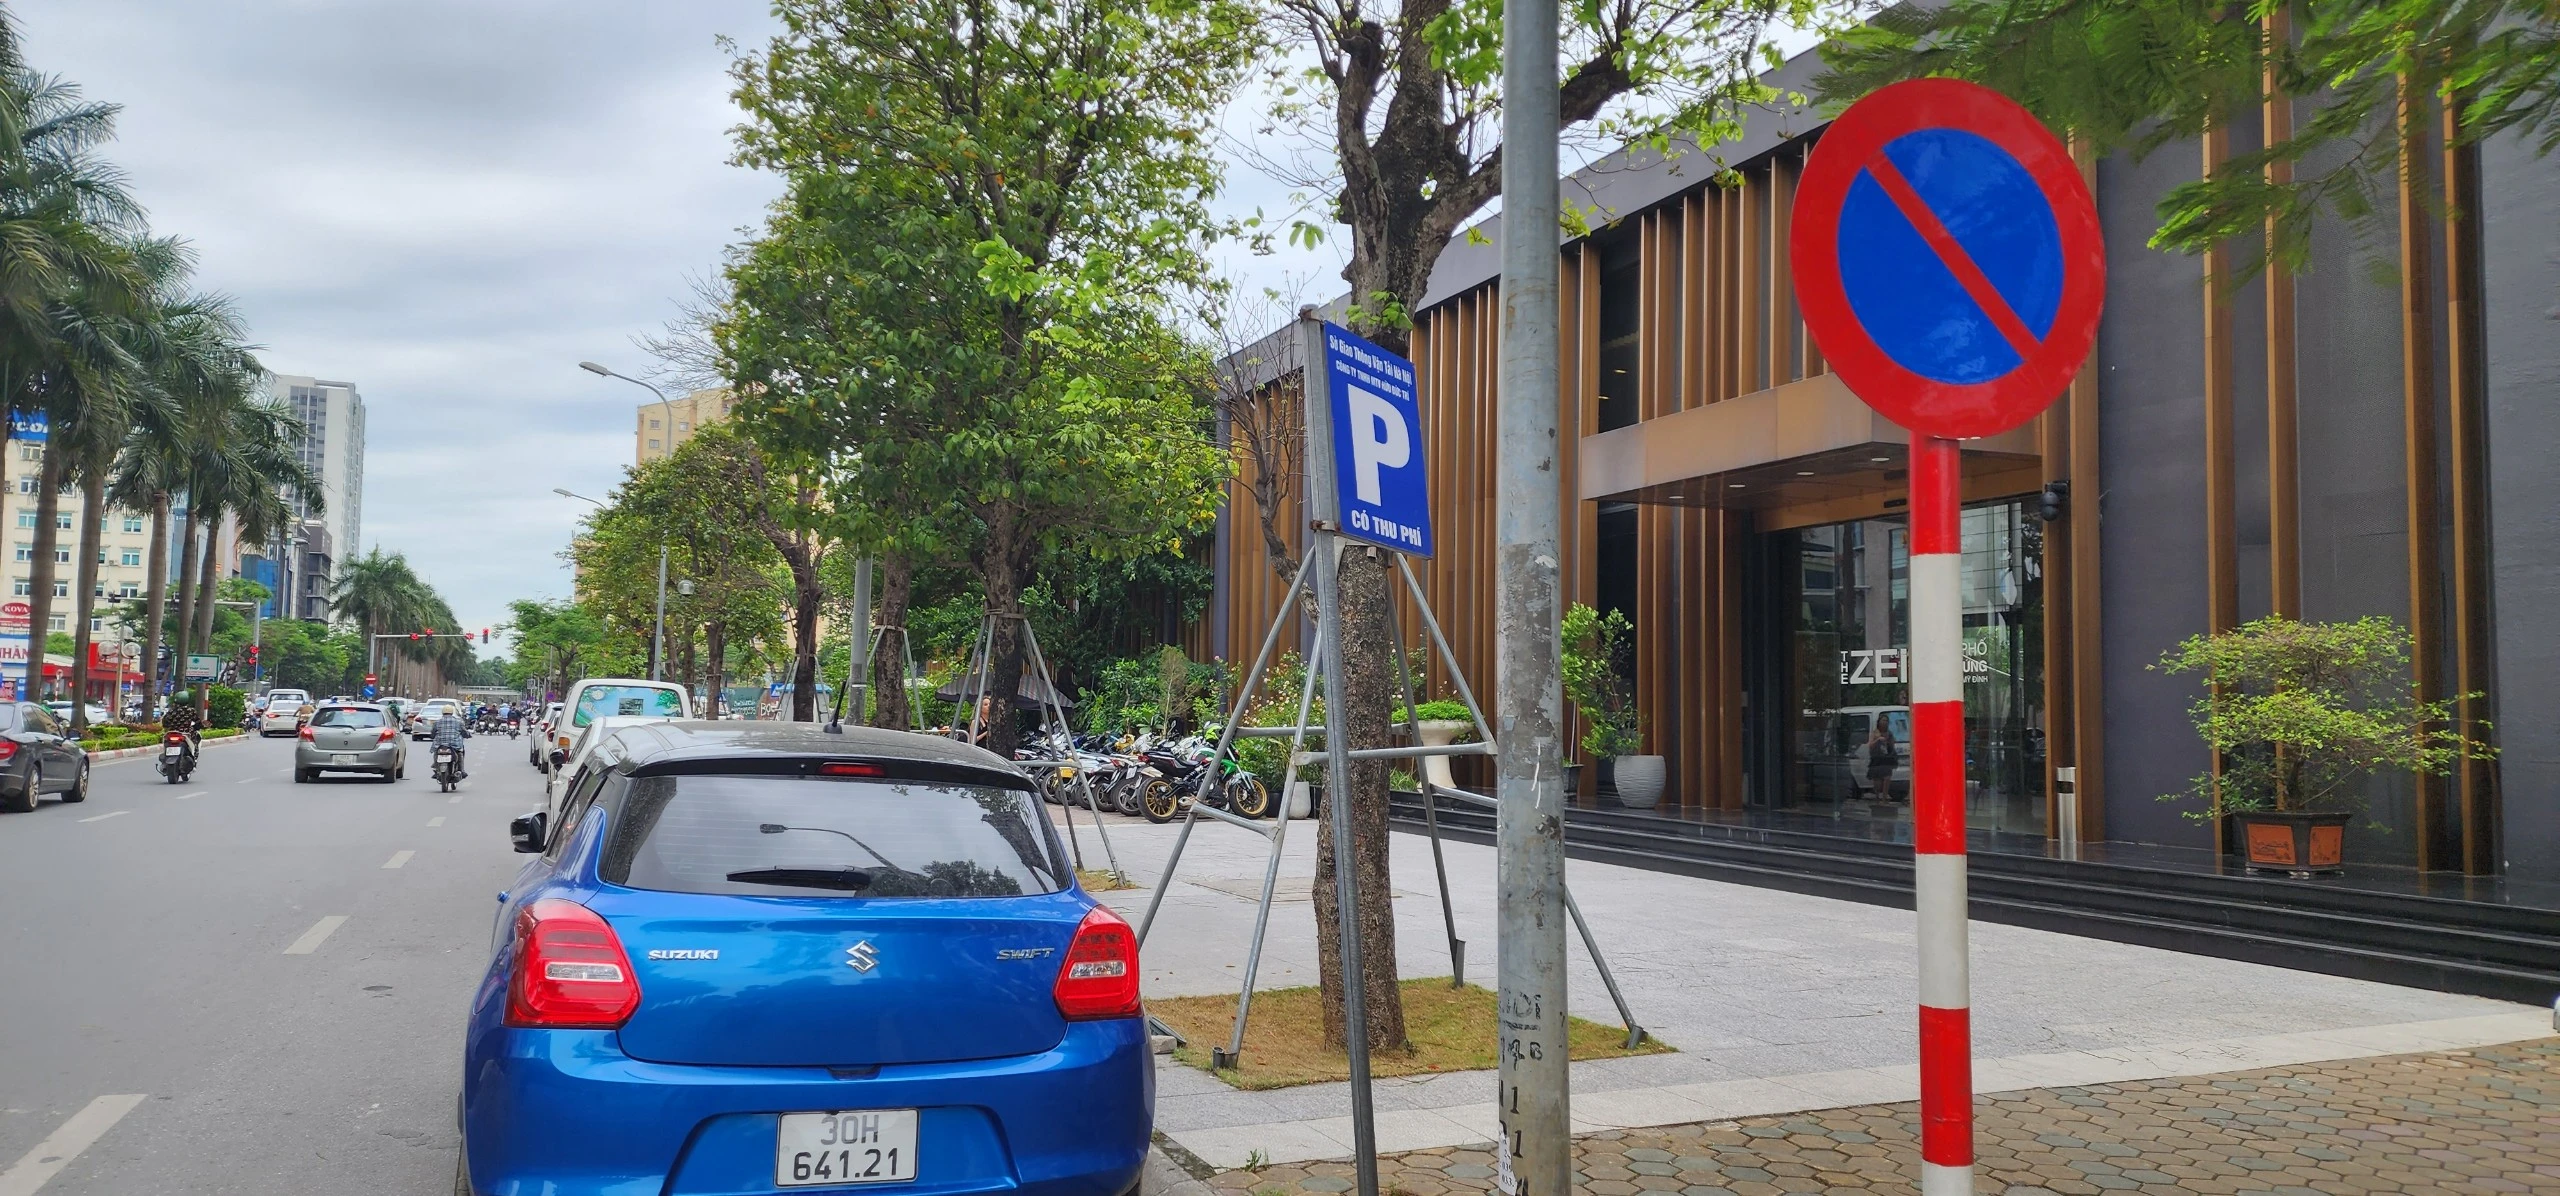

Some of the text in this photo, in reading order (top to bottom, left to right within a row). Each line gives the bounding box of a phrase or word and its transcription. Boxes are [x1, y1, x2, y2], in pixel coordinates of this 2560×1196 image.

[1339, 339, 1354, 357] Giao
[1350, 365, 1357, 378] TY
[1347, 383, 1411, 507] P
[1351, 509, 1422, 547] CÓ THU PHÍ
[4, 605, 28, 613] KOVA
[648, 949, 719, 960] SUZUKI
[996, 947, 1055, 960] SWIFT
[820, 1114, 879, 1146] 30H
[793, 1147, 898, 1181] 641.21
